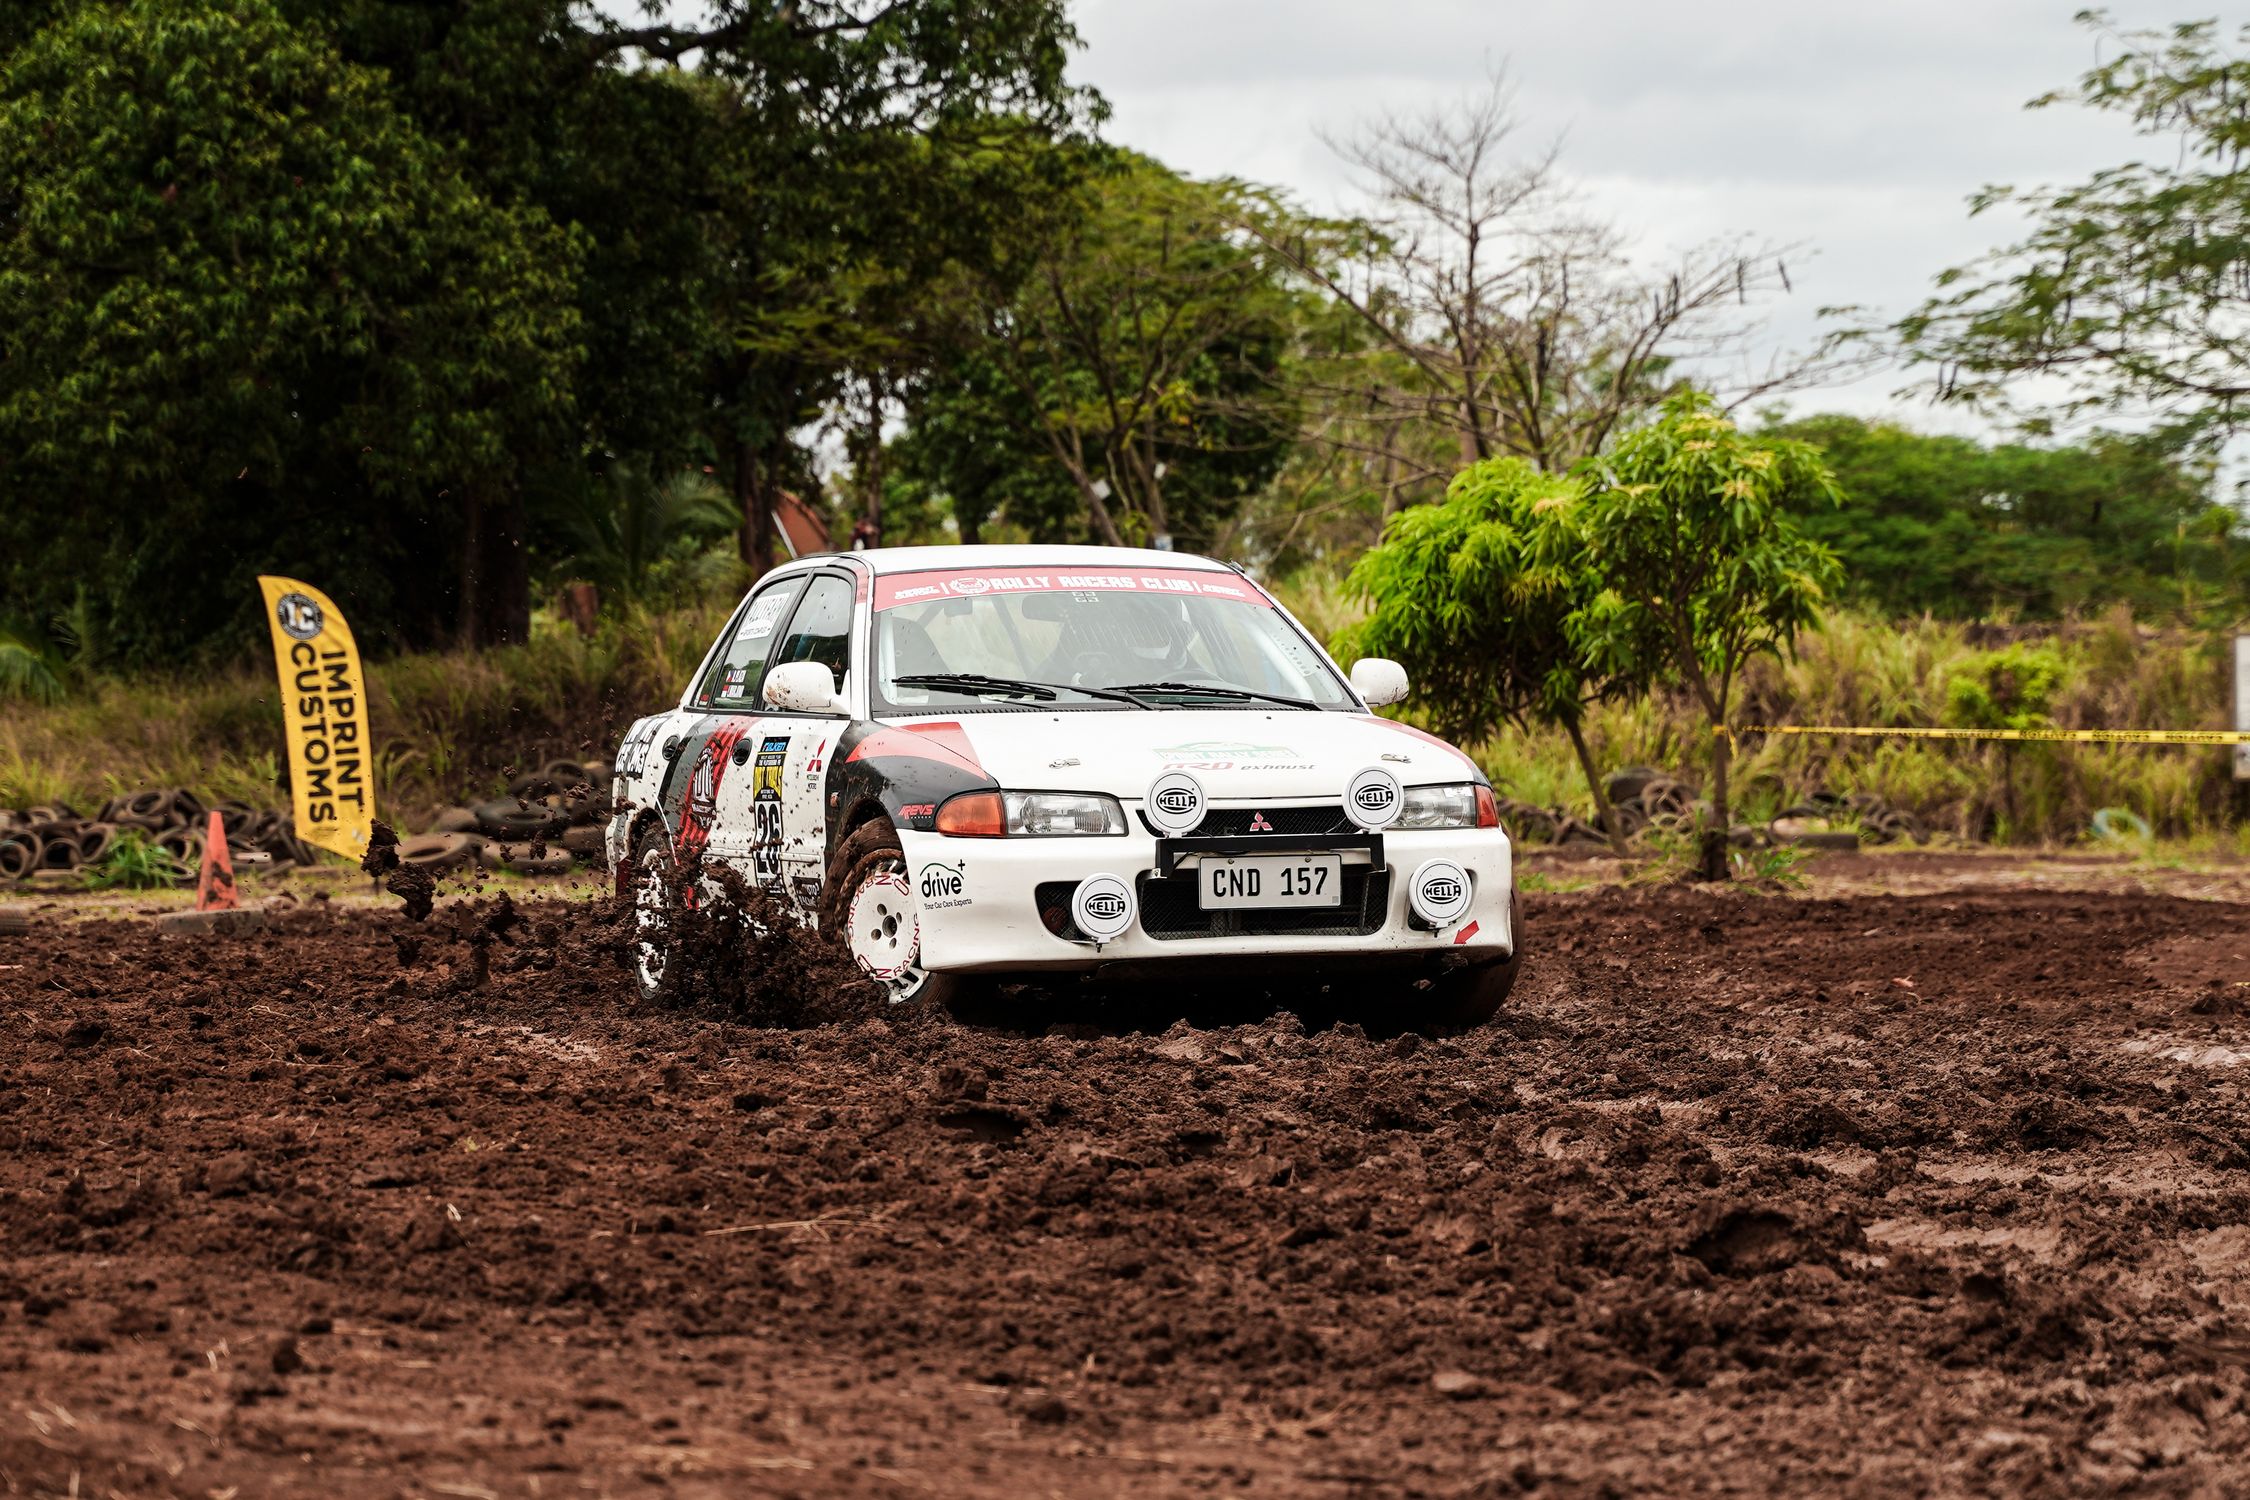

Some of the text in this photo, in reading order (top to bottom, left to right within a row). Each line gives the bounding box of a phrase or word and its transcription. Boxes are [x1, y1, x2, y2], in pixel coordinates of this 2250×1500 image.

[988, 576, 1050, 590] RALLY
[1057, 576, 1136, 589] RACERS
[1141, 577, 1194, 592] CLUB
[291, 643, 336, 823] CUSTOMS
[321, 651, 364, 807] IMPRINT
[1160, 795, 1197, 808] HELLA
[1358, 790, 1394, 803] HELLA
[1213, 867, 1328, 898] CND 157
[1426, 884, 1462, 897] HELLA
[1089, 900, 1126, 913] HELLA
